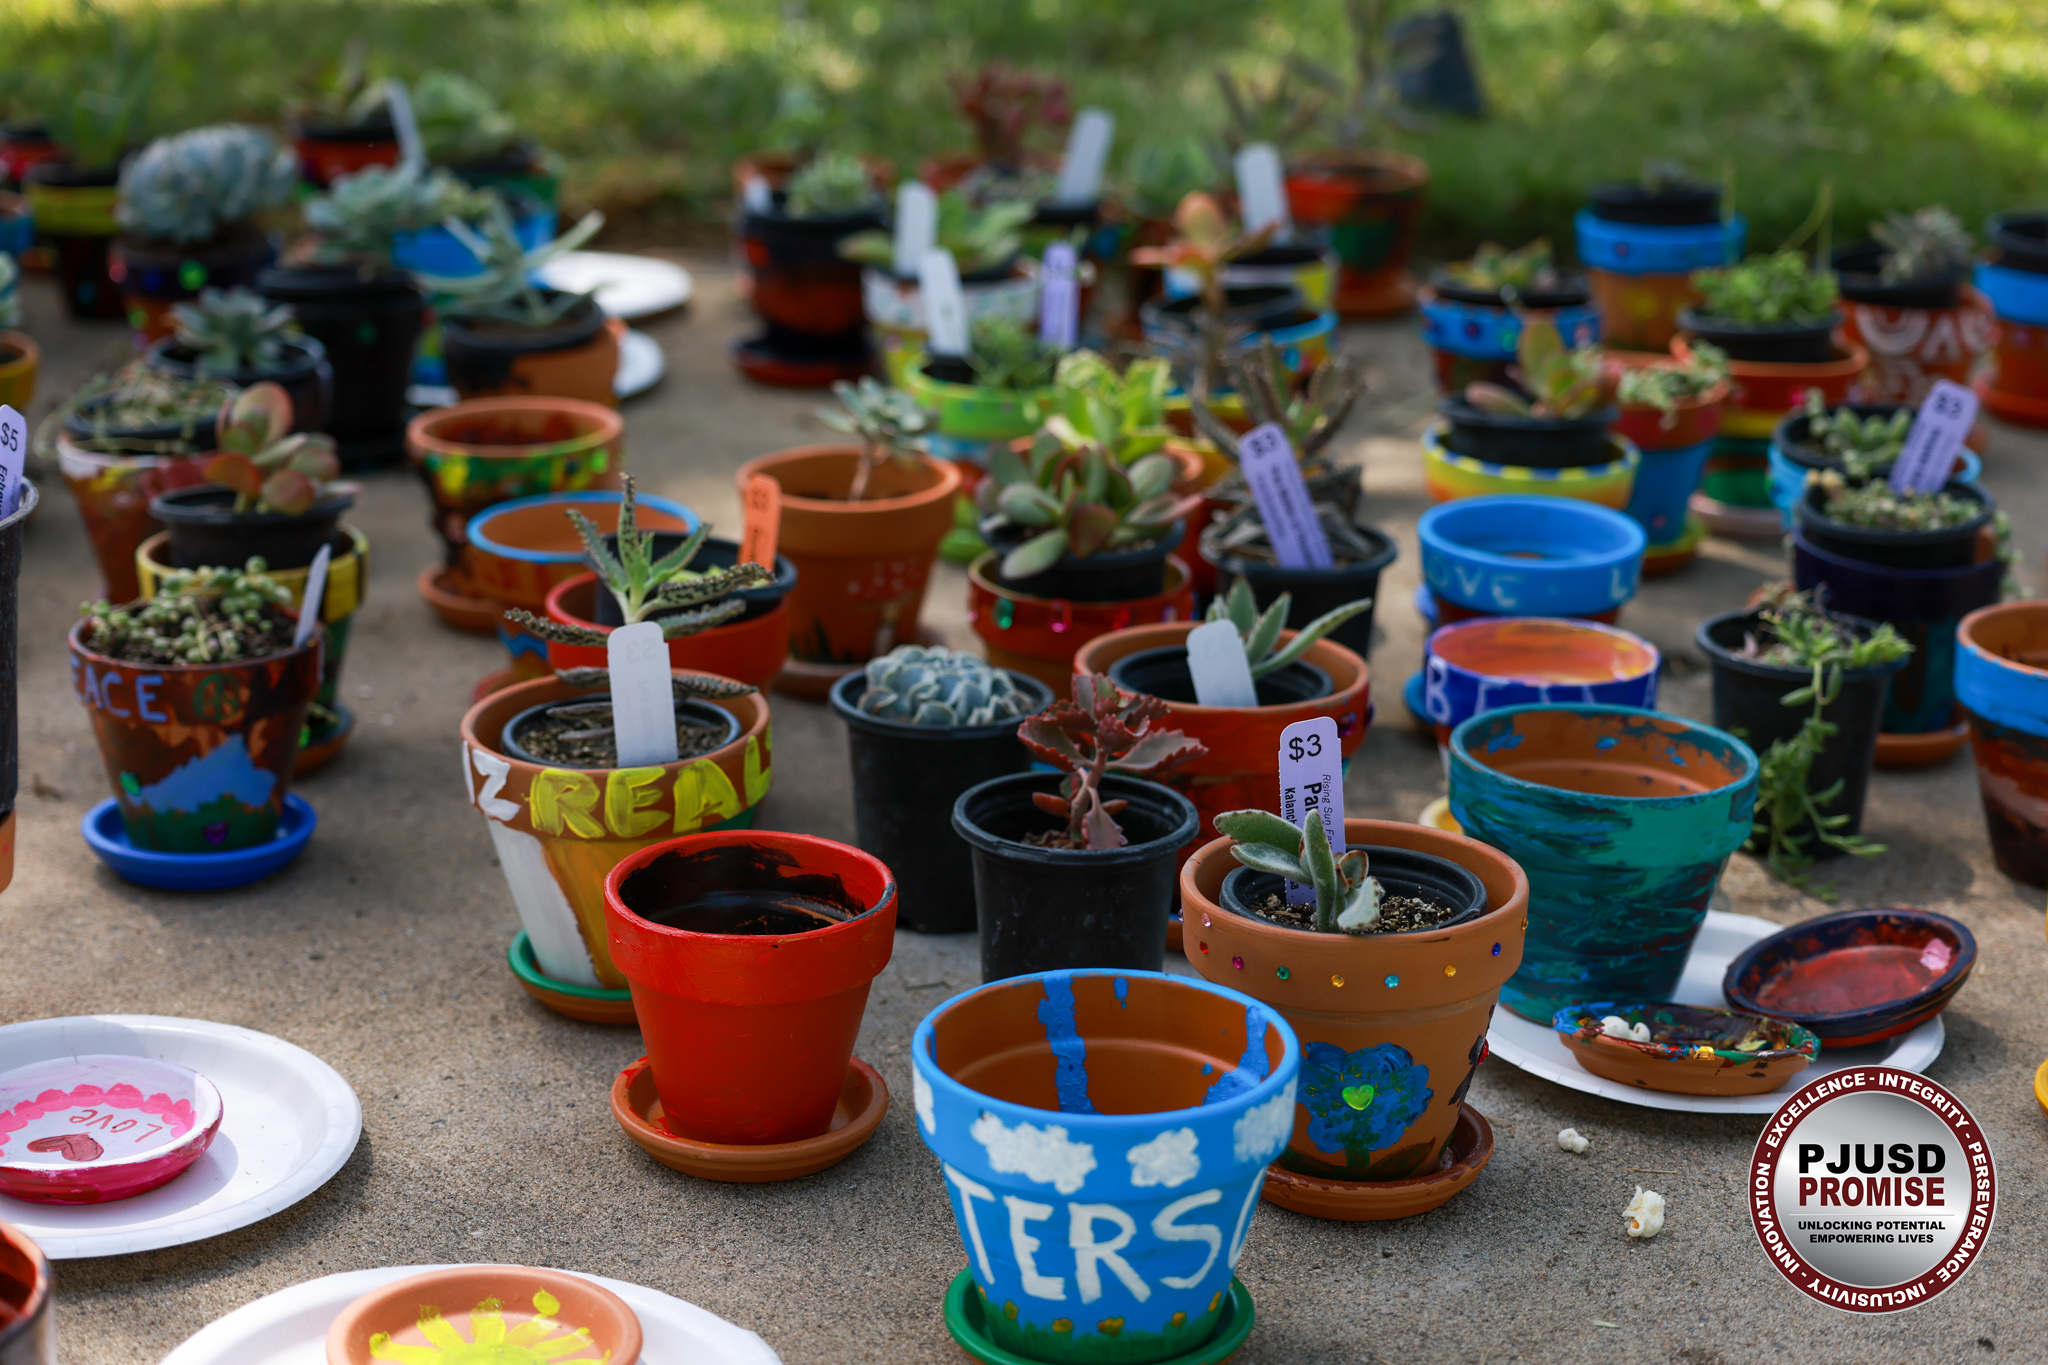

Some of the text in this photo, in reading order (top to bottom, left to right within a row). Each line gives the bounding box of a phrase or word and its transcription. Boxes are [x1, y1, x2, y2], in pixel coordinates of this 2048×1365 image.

[0, 422, 19, 452] $5
[1288, 733, 1323, 763] $3
[1322, 774, 1332, 804] Rising
[1323, 806, 1333, 826] Sun
